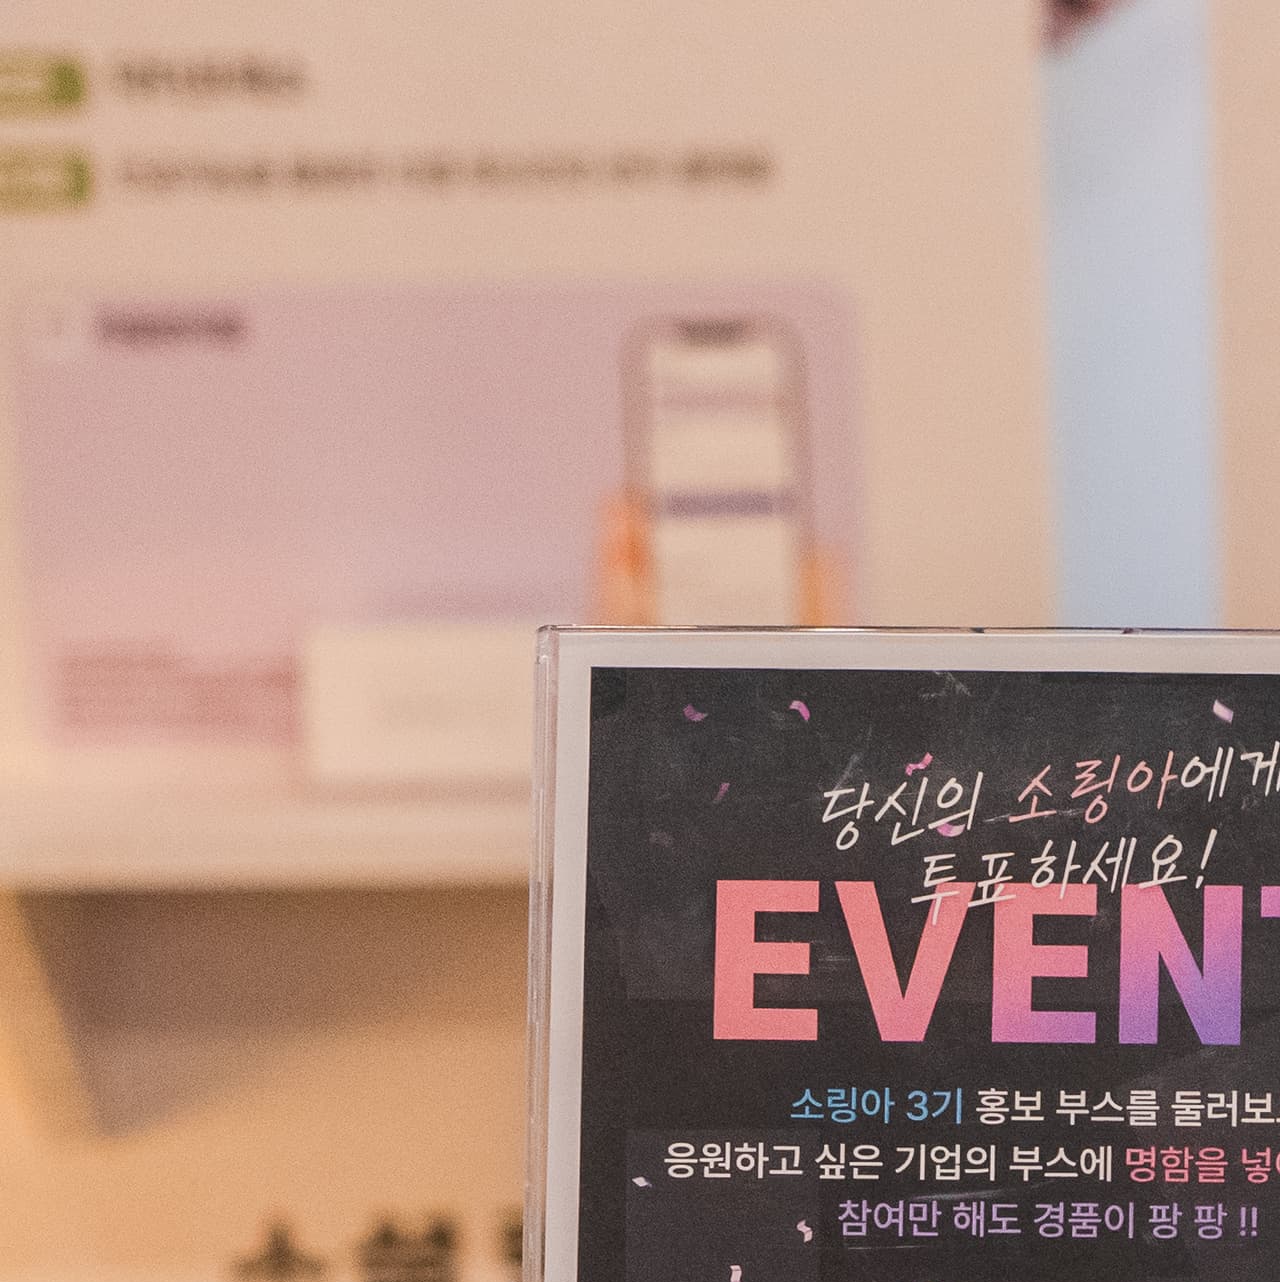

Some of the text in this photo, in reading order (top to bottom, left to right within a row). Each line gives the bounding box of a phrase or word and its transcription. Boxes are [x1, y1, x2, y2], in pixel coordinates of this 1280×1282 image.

[821, 770, 984, 851] 당신의
[911, 828, 1218, 926] 투표하세요!
[790, 1087, 895, 1124] 소링아
[906, 1087, 963, 1125] 3기
[976, 1088, 1045, 1126] 홍보
[1055, 1089, 1161, 1126] 부스를
[663, 1141, 804, 1180] 응원하고
[814, 1143, 884, 1181] 싶은
[895, 1144, 997, 1182] 기업의
[1009, 1145, 1113, 1183] 부스에
[1124, 1146, 1229, 1184] 명함을
[838, 1199, 943, 1238] 참여만
[953, 1200, 1023, 1239] 해도
[1033, 1201, 1135, 1239] 경품이
[1148, 1202, 1183, 1240] 팡
[1193, 1202, 1228, 1240] 팡
